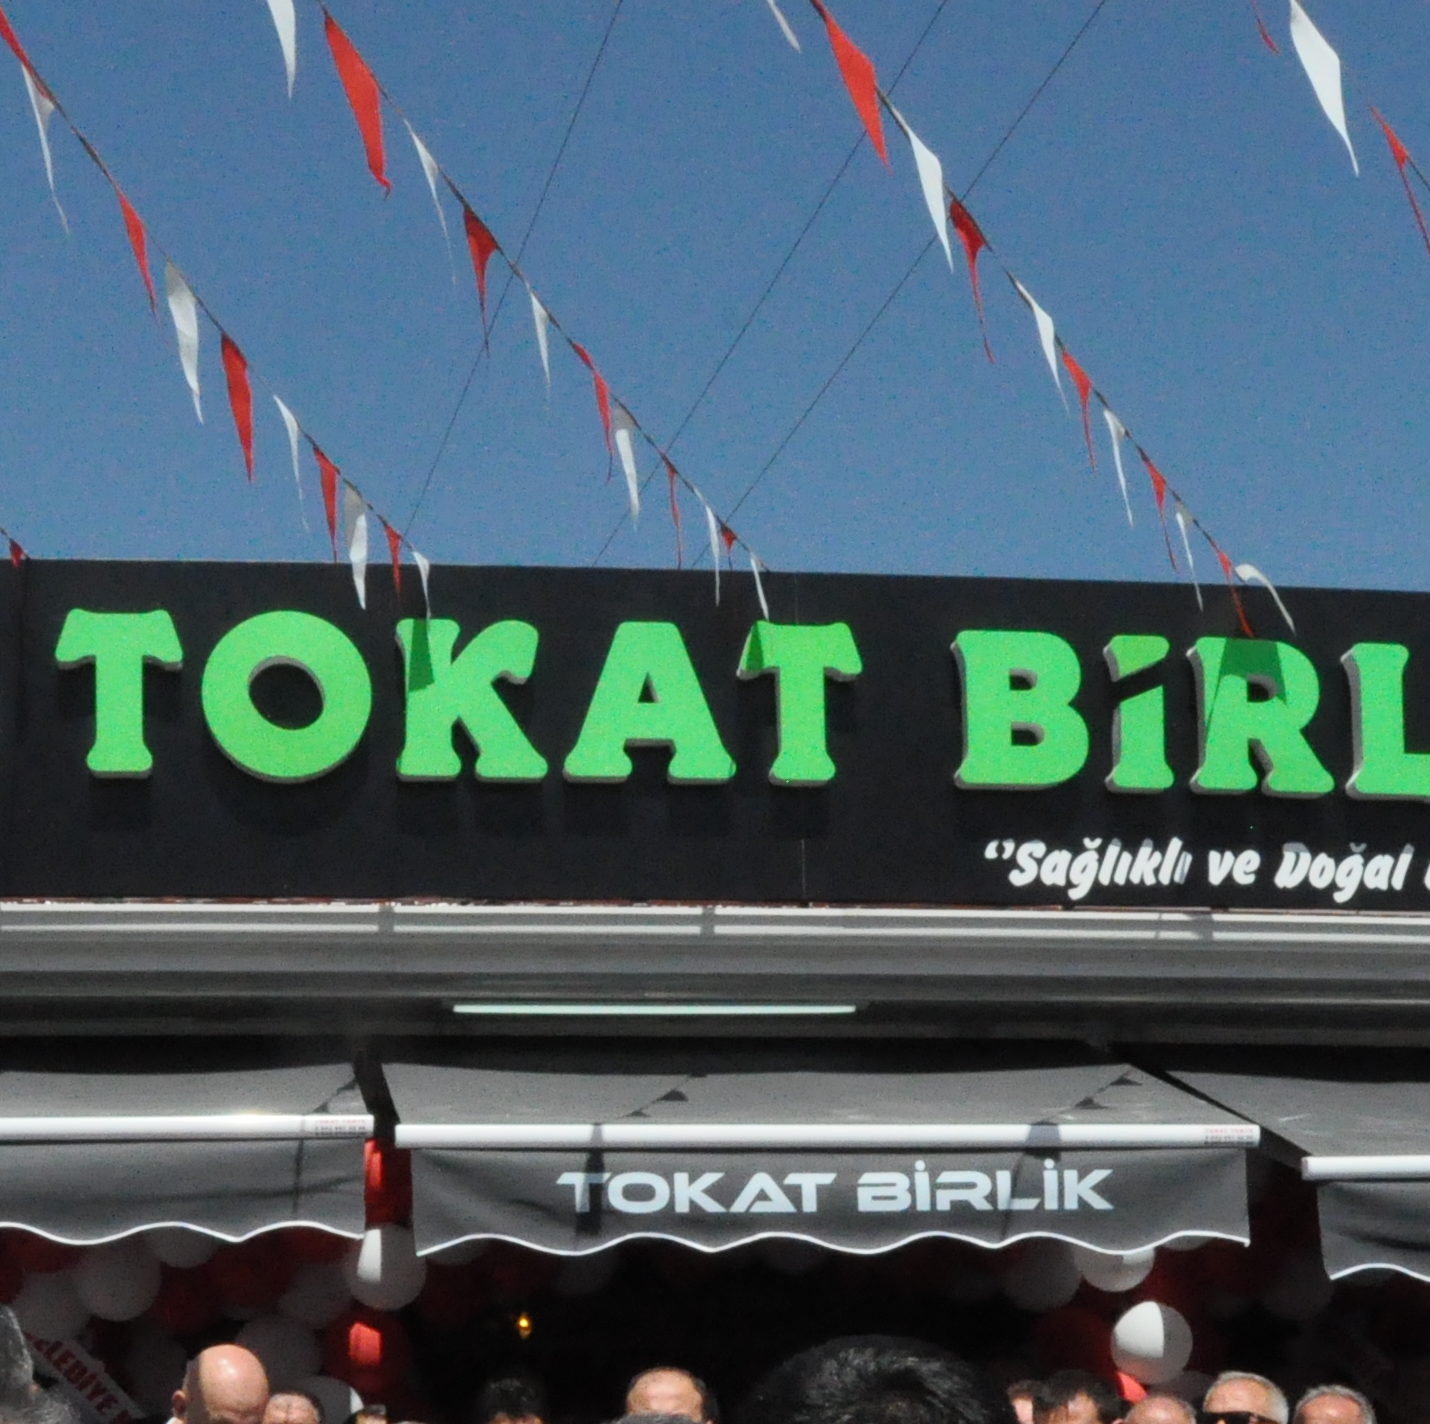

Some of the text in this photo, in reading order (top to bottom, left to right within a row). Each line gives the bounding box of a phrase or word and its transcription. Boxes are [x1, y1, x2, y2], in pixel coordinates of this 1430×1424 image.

[55, 608, 863, 788] TOKAT
[1208, 849, 1261, 886] ve
[1274, 842, 1414, 904] Doğal
[555, 1159, 1114, 1214] TOKAT BİRLİK
